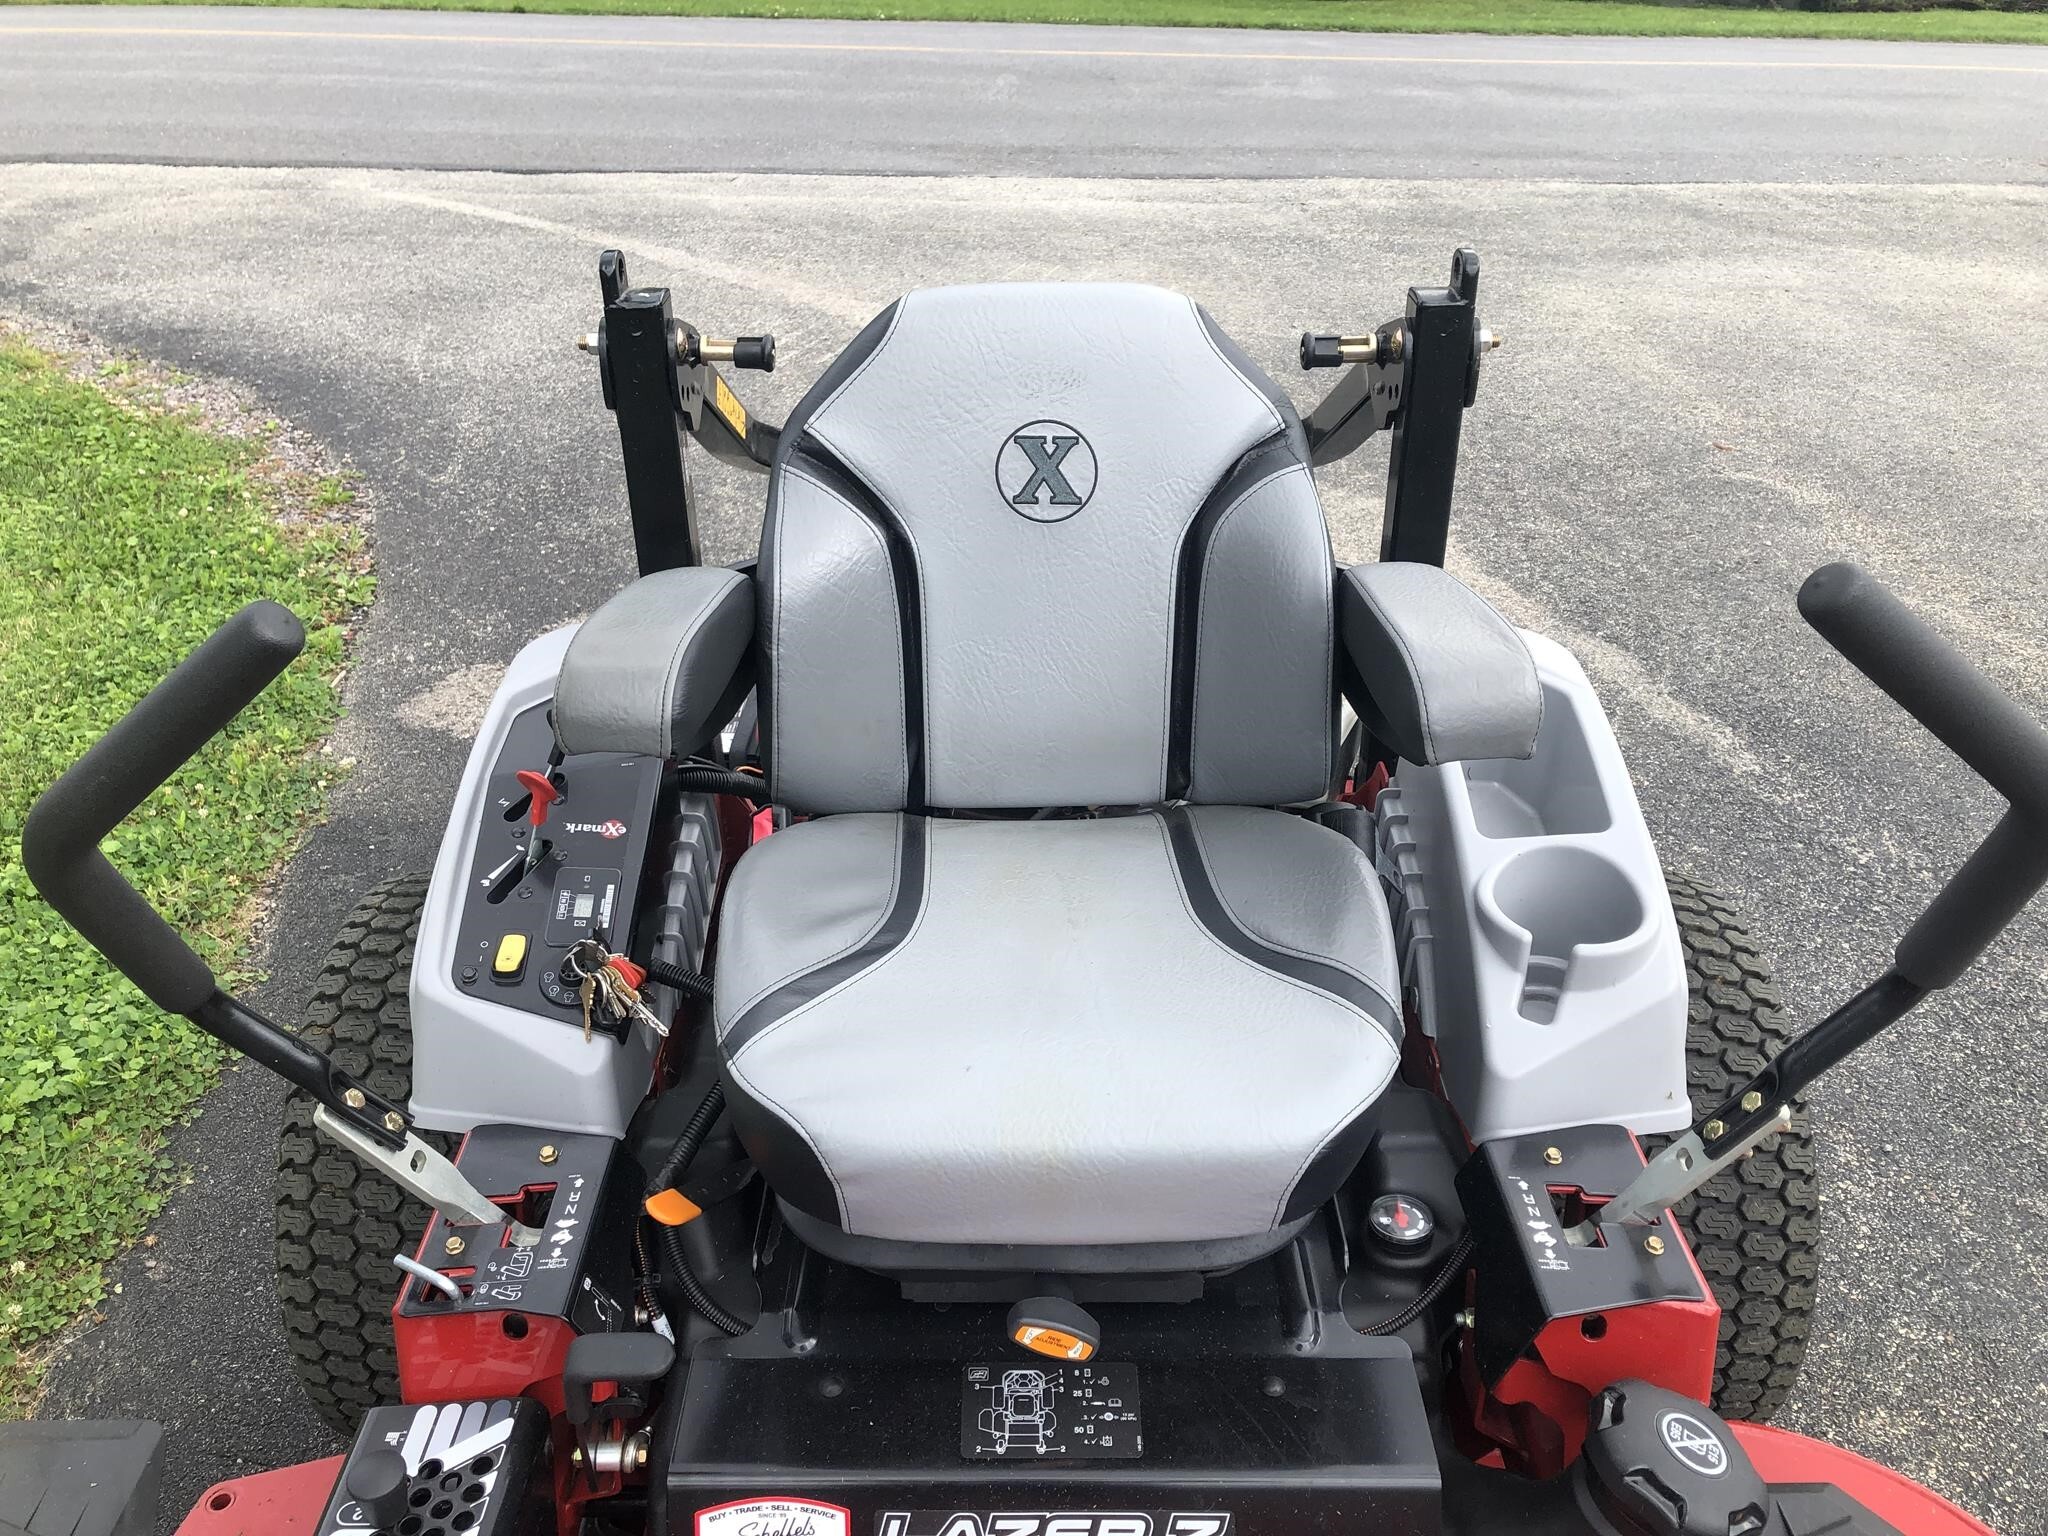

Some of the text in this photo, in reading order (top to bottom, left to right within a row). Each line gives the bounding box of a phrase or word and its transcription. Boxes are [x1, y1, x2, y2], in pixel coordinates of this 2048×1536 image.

[1013, 435, 1082, 505] X
[568, 1191, 581, 1202] R
[1522, 1193, 1536, 1204] R
[564, 1204, 578, 1215] N
[1526, 1206, 1541, 1217] N
[1074, 1426, 1084, 1434] 50
[1707, 1444, 1720, 1465] E15
[708, 1504, 837, 1523] BUY TRADE SELL SERVICE
